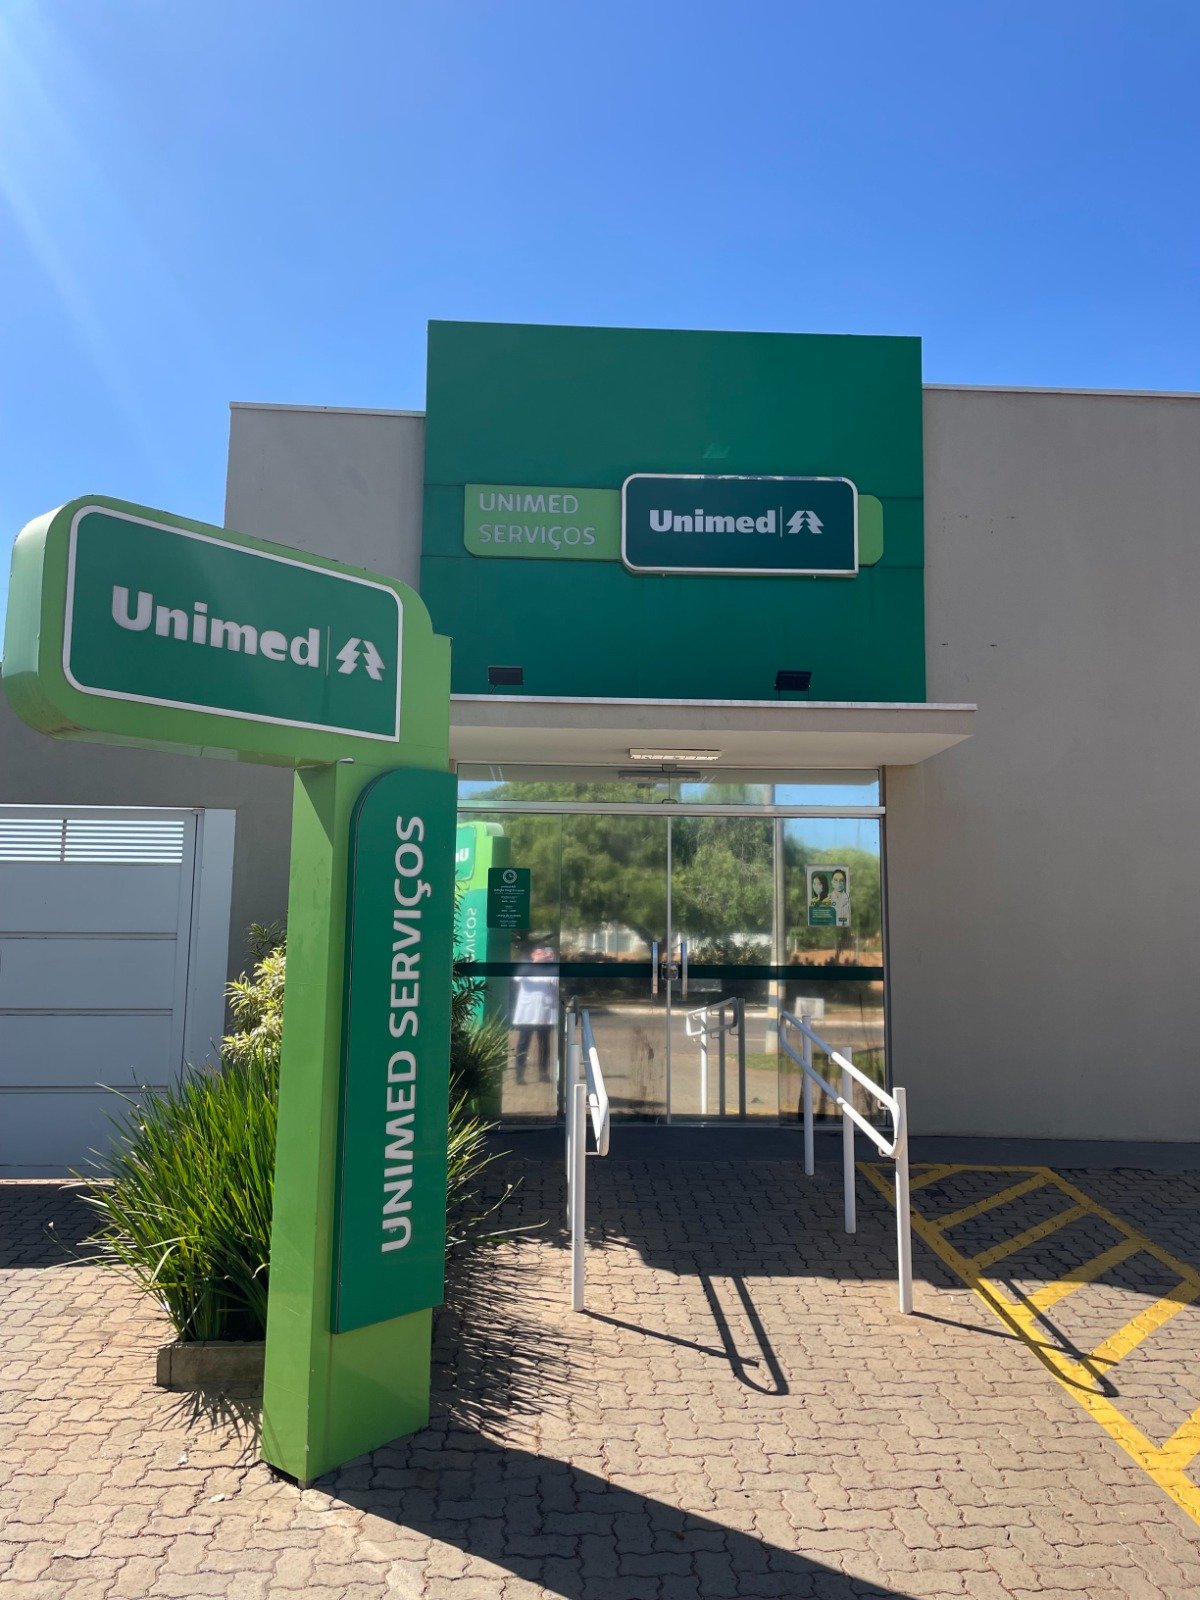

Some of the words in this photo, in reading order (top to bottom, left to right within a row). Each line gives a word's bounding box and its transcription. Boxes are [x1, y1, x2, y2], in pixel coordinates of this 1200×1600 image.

[479, 493, 579, 514] UNIMED
[649, 508, 776, 534] Unimed
[479, 524, 596, 551] SERVIÇOS
[111, 585, 320, 668] Unimed
[389, 815, 432, 1037] SERVIÇOS
[381, 1049, 417, 1253] UNIMED
